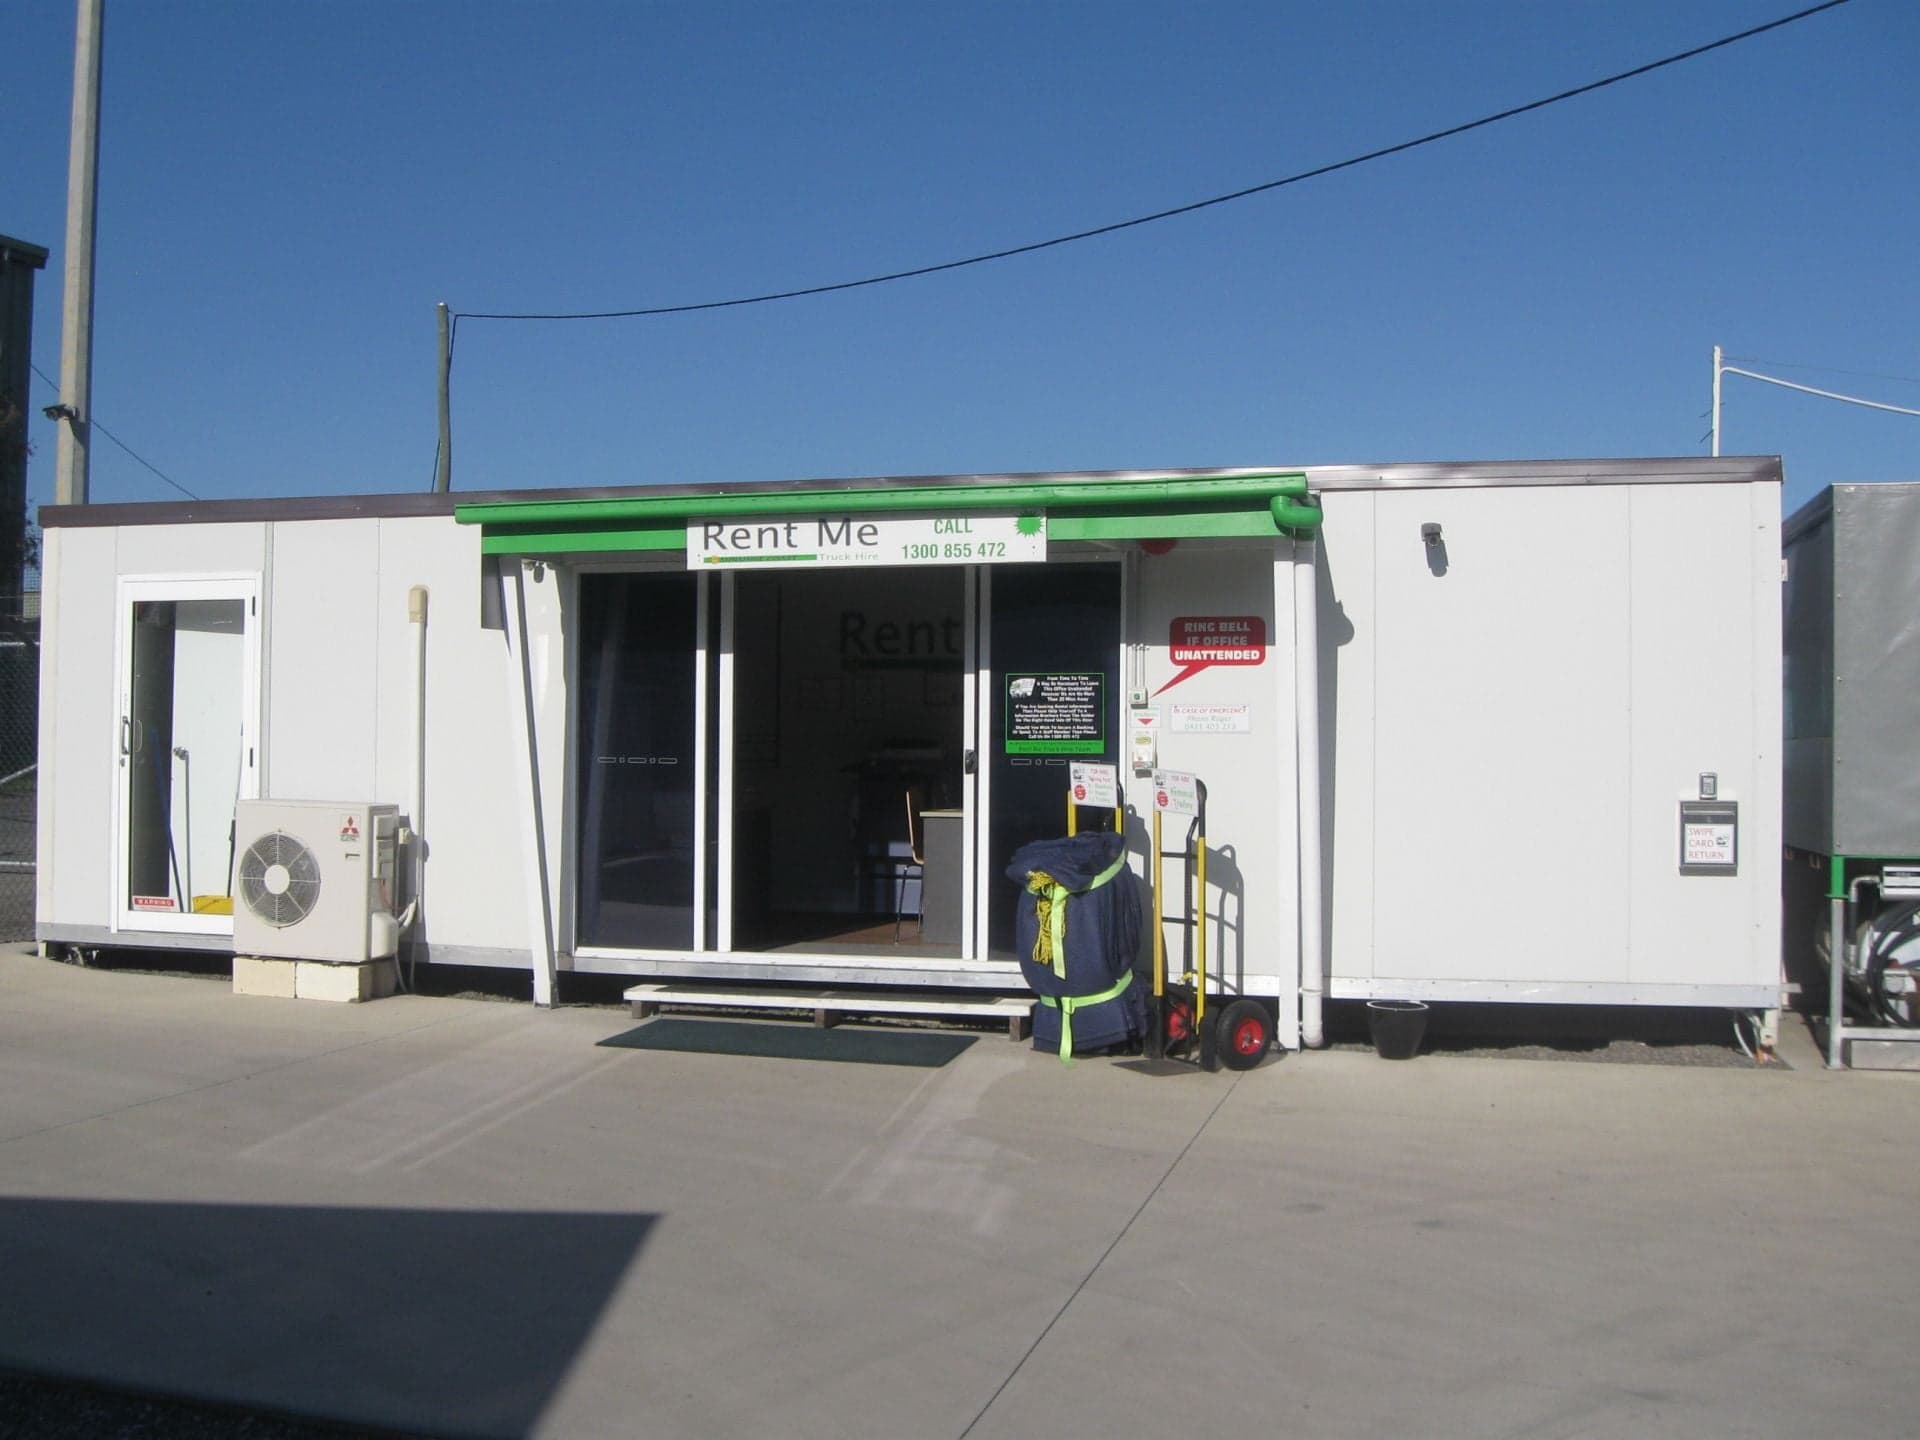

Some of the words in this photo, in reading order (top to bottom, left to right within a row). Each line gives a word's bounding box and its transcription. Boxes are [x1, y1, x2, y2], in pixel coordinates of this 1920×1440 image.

[934, 519, 973, 534] CALL
[703, 521, 798, 551] Rent
[818, 517, 879, 547] Me
[902, 544, 938, 559] 1300
[944, 543, 972, 558] 855
[977, 542, 1006, 557] 472
[820, 553, 849, 561] Truck
[855, 552, 879, 561] Hire
[1184, 622, 1215, 632] RING
[1219, 622, 1250, 631] BELL
[840, 611, 961, 655] Rent
[1187, 636, 1199, 646] IF
[1203, 636, 1248, 645] OFFICE
[1175, 649, 1260, 660] UNATTENDED
[1688, 840, 1714, 848] CARD
[1688, 850, 1725, 859] RETURN
